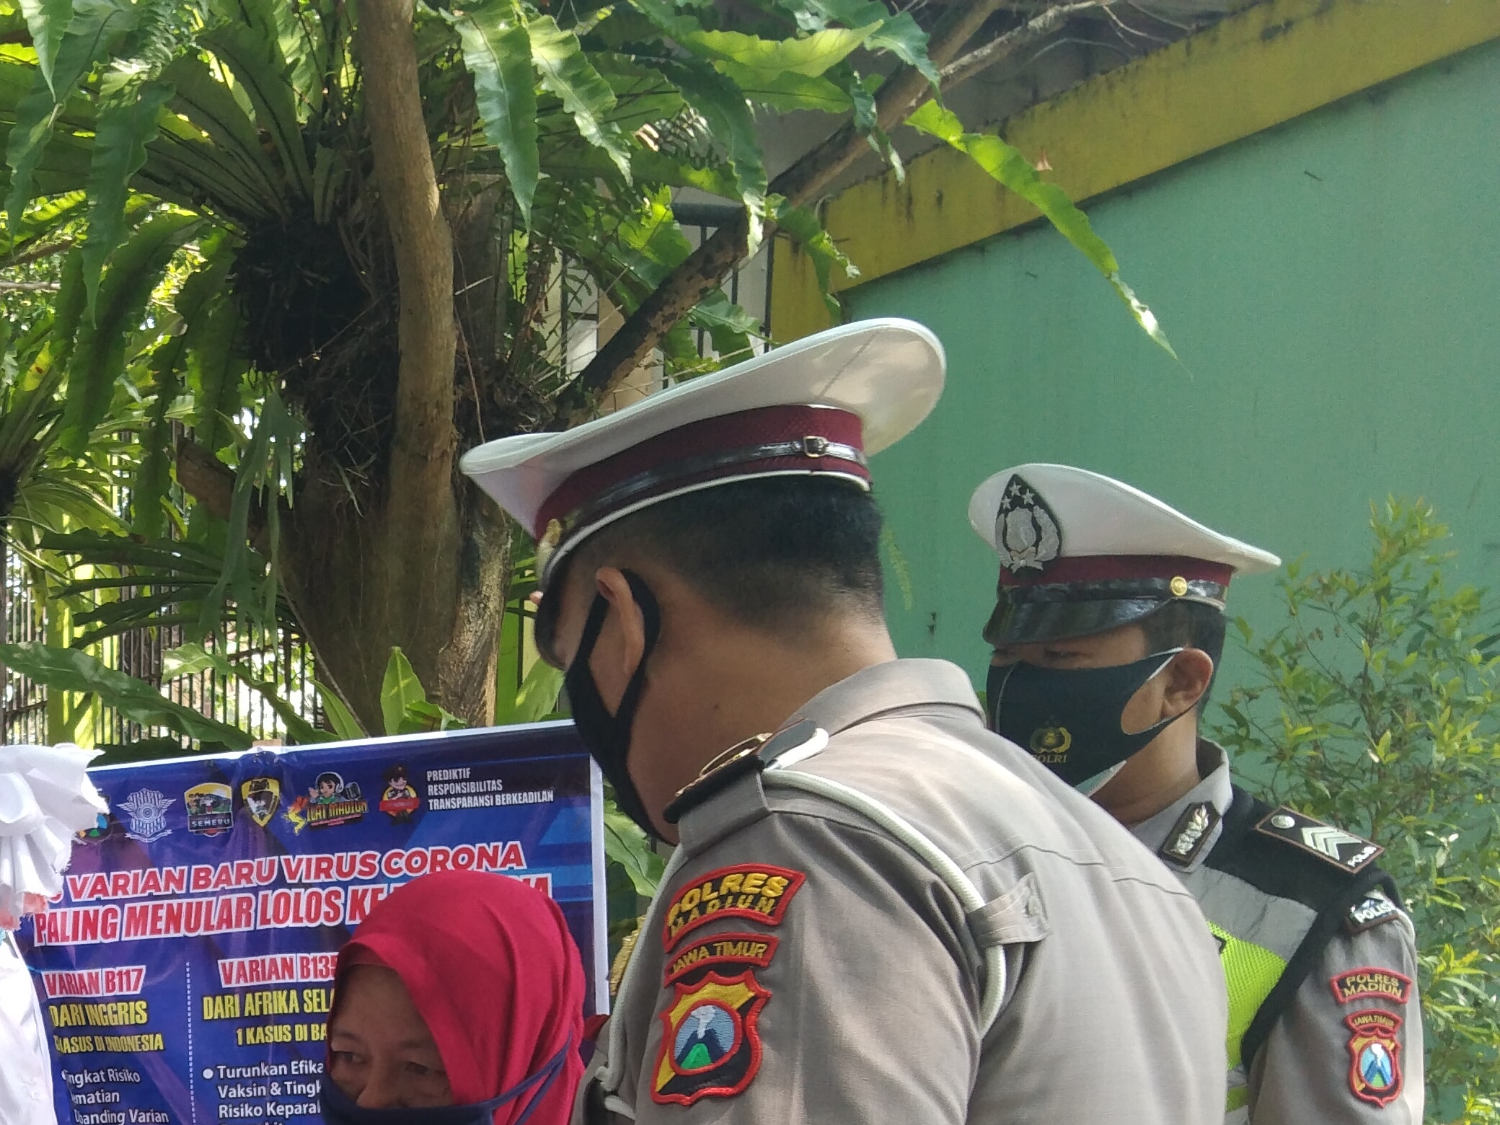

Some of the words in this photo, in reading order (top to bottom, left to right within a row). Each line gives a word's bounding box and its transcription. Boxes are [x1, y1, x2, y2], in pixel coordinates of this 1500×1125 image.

[426, 767, 471, 782] PREDIKTIF
[427, 779, 503, 797] RESPONSIBILITAS
[428, 794, 493, 811] TRANSPARANSI
[495, 790, 554, 806] BERKEADILAN
[67, 866, 186, 902] VARIAN
[190, 855, 277, 892] BARU
[281, 850, 380, 883] VIRUS
[382, 841, 526, 880] CORONA
[667, 872, 789, 927] POLRES
[34, 904, 121, 947] PALING
[121, 893, 255, 941] MENULAR
[257, 887, 344, 928] LOLOS
[713, 941, 768, 958] TIMUR
[218, 953, 296, 988] VARIAN
[41, 967, 102, 998] VARIAN
[102, 965, 146, 995] B117
[1346, 973, 1399, 987] POLRES
[1343, 983, 1402, 998] MADIUN
[203, 995, 240, 1019] DARI
[244, 989, 299, 1017] AFRIKA
[235, 1029, 242, 1045] 1
[246, 1025, 292, 1045] KASUS
[295, 1024, 308, 1041] DI
[107, 1068, 140, 1083] Risiko
[217, 1063, 288, 1079] Turunkan
[291, 1060, 324, 1075] Efika
[218, 1084, 266, 1099] Vaksin
[270, 1082, 282, 1097] &
[129, 1109, 169, 1124] Varian
[218, 1103, 263, 1119] Risiko
